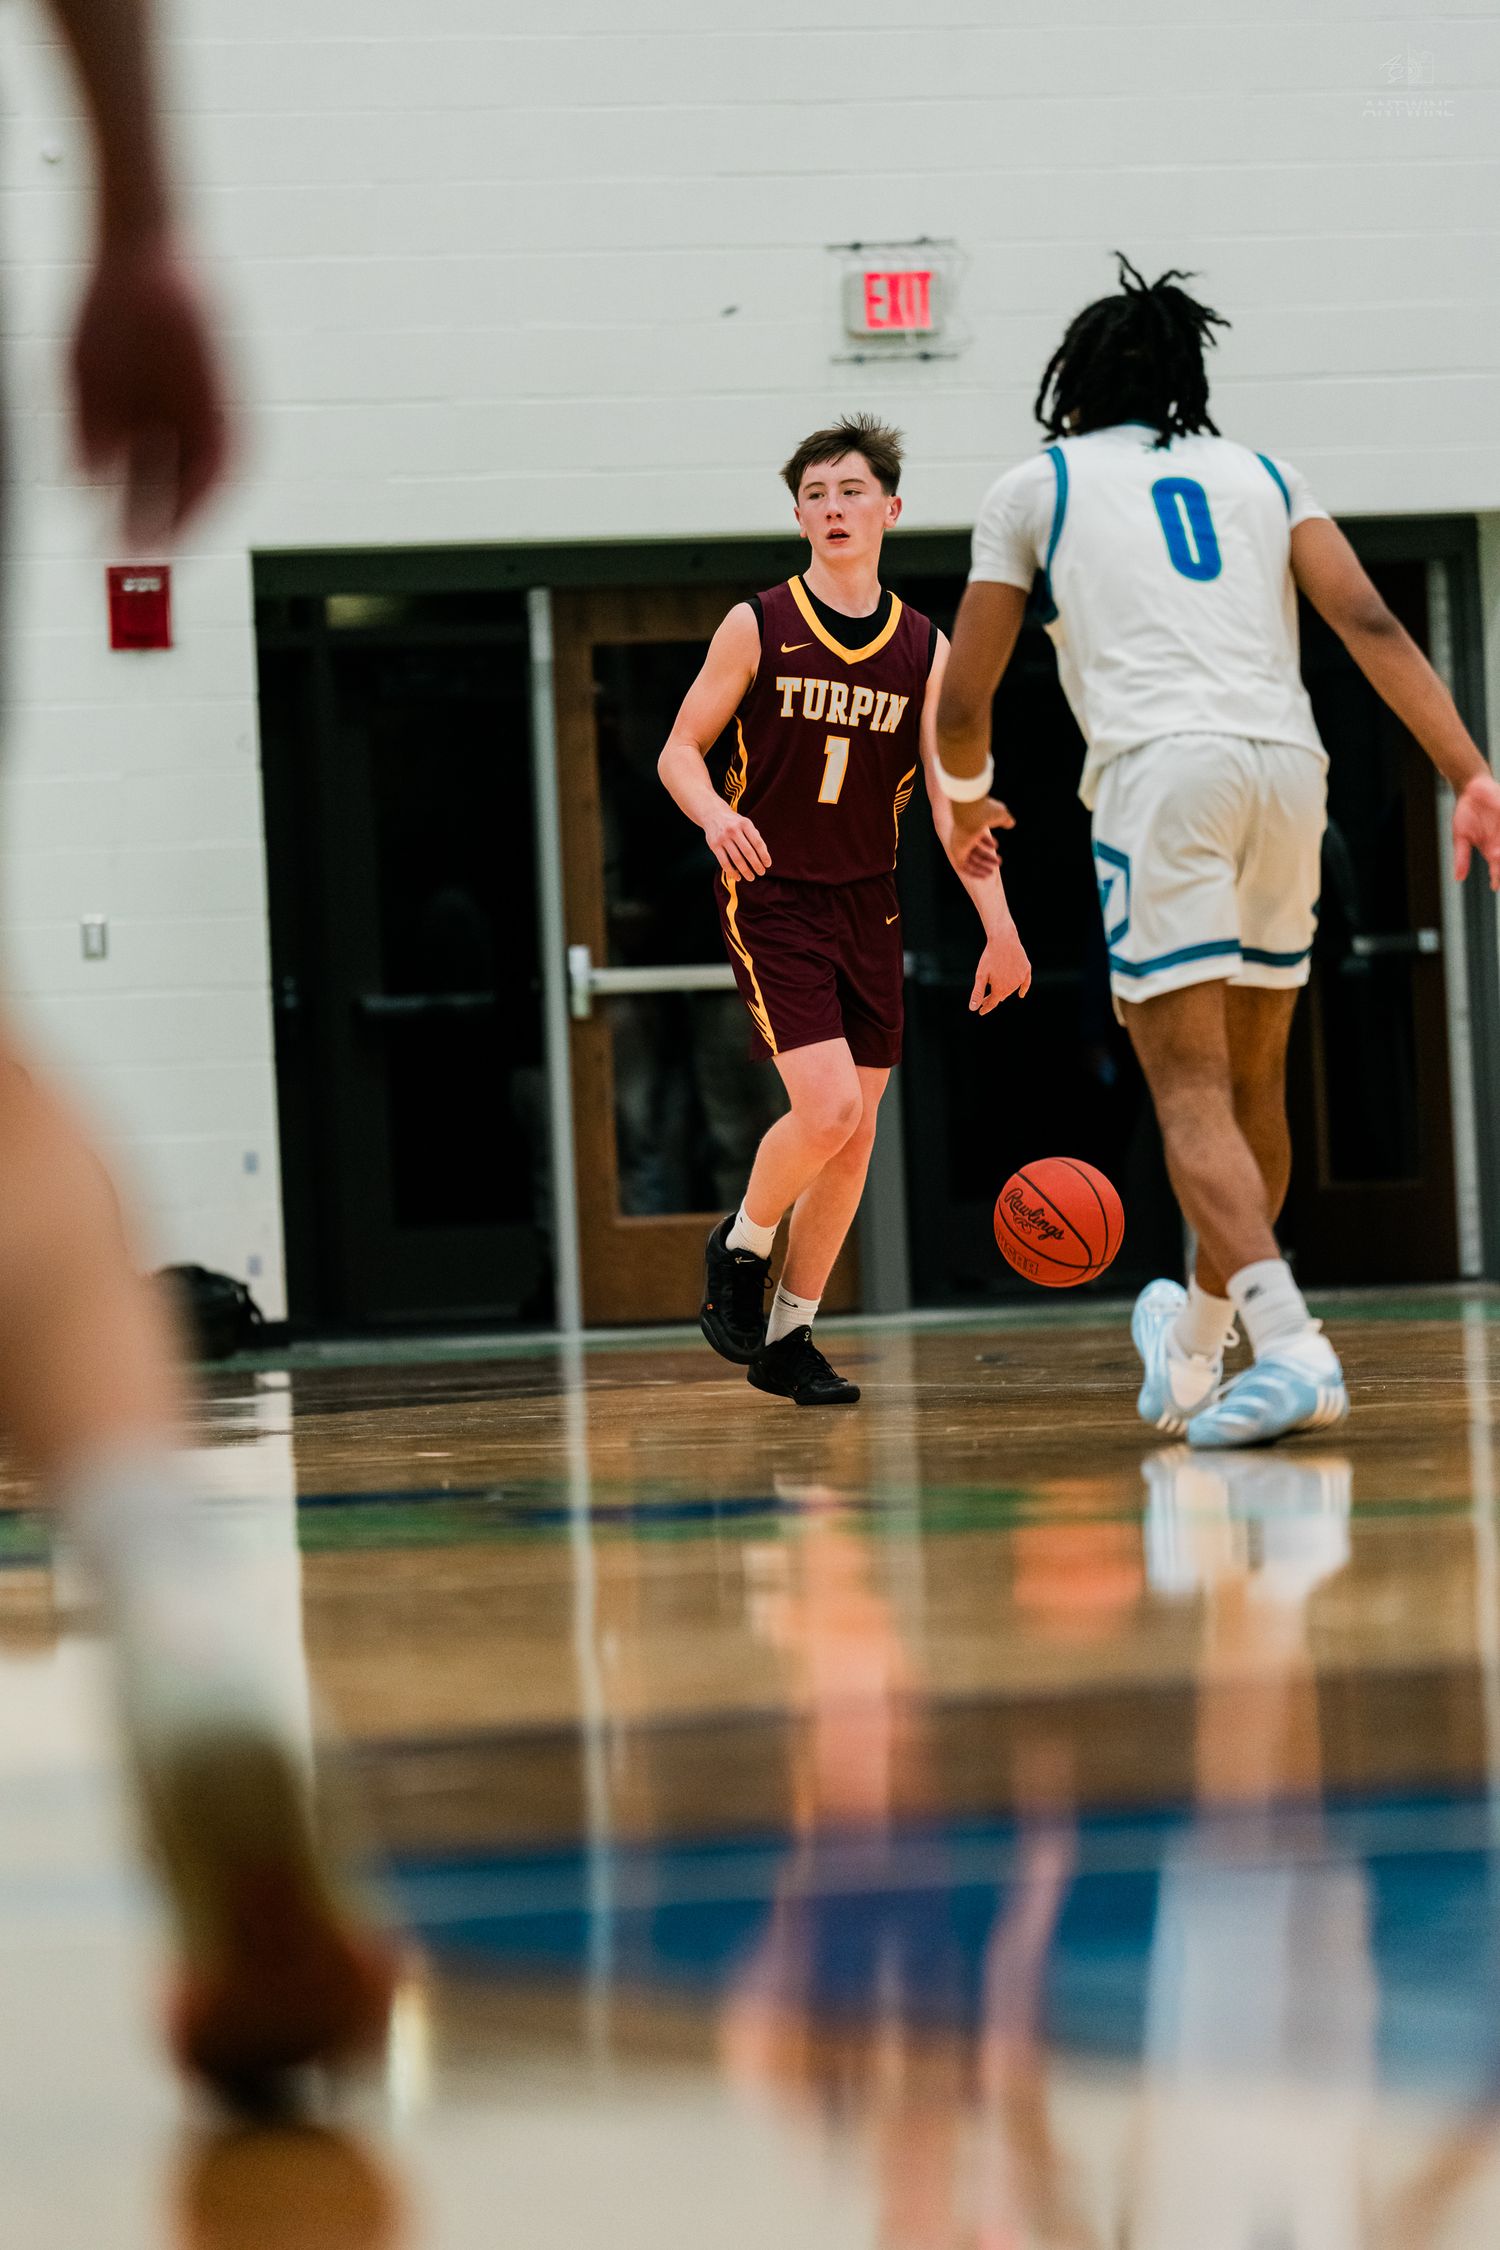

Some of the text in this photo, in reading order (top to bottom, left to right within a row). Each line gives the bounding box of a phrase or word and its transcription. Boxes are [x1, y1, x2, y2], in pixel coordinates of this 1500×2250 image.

[864, 271, 931, 329] EXIT
[1151, 476, 1222, 581] 0
[775, 676, 910, 734] TURPIN
[817, 735, 851, 805] 1
[1004, 1187, 1065, 1240] Rawlings
